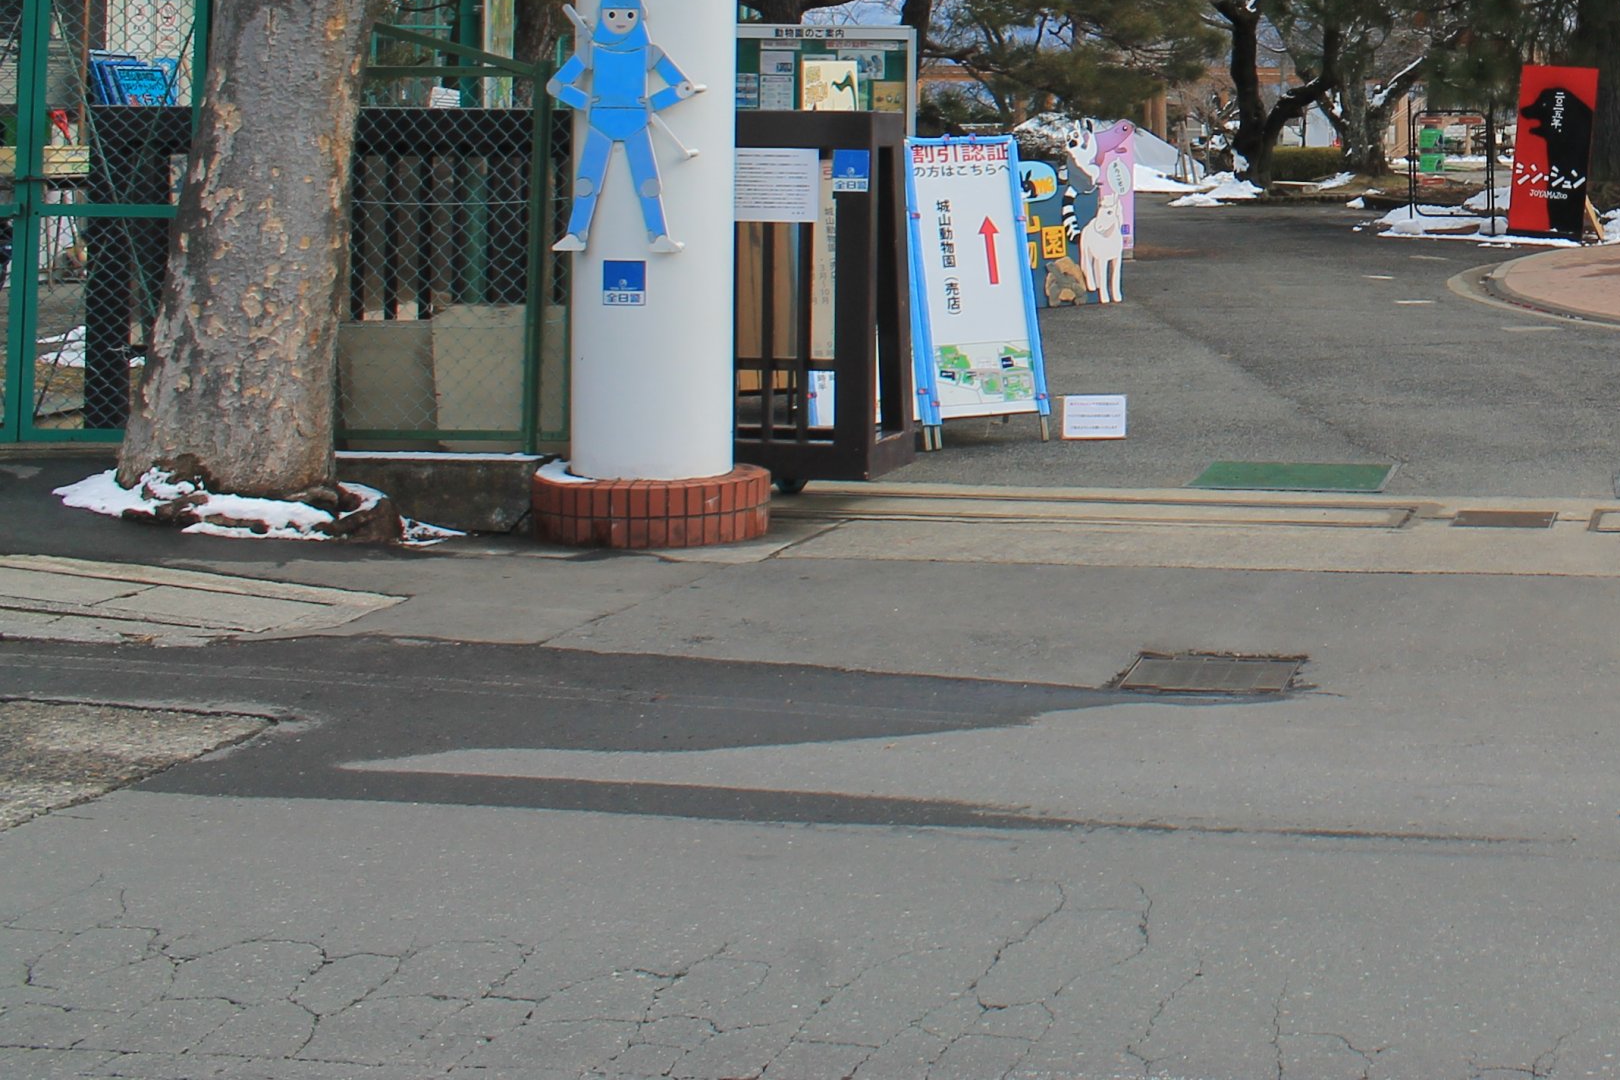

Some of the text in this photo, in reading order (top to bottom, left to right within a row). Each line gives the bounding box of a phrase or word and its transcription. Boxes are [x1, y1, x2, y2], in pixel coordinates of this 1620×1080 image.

[913, 164, 1010, 178] の方はこちらへ
[1515, 162, 1587, 189] シン・シュン
